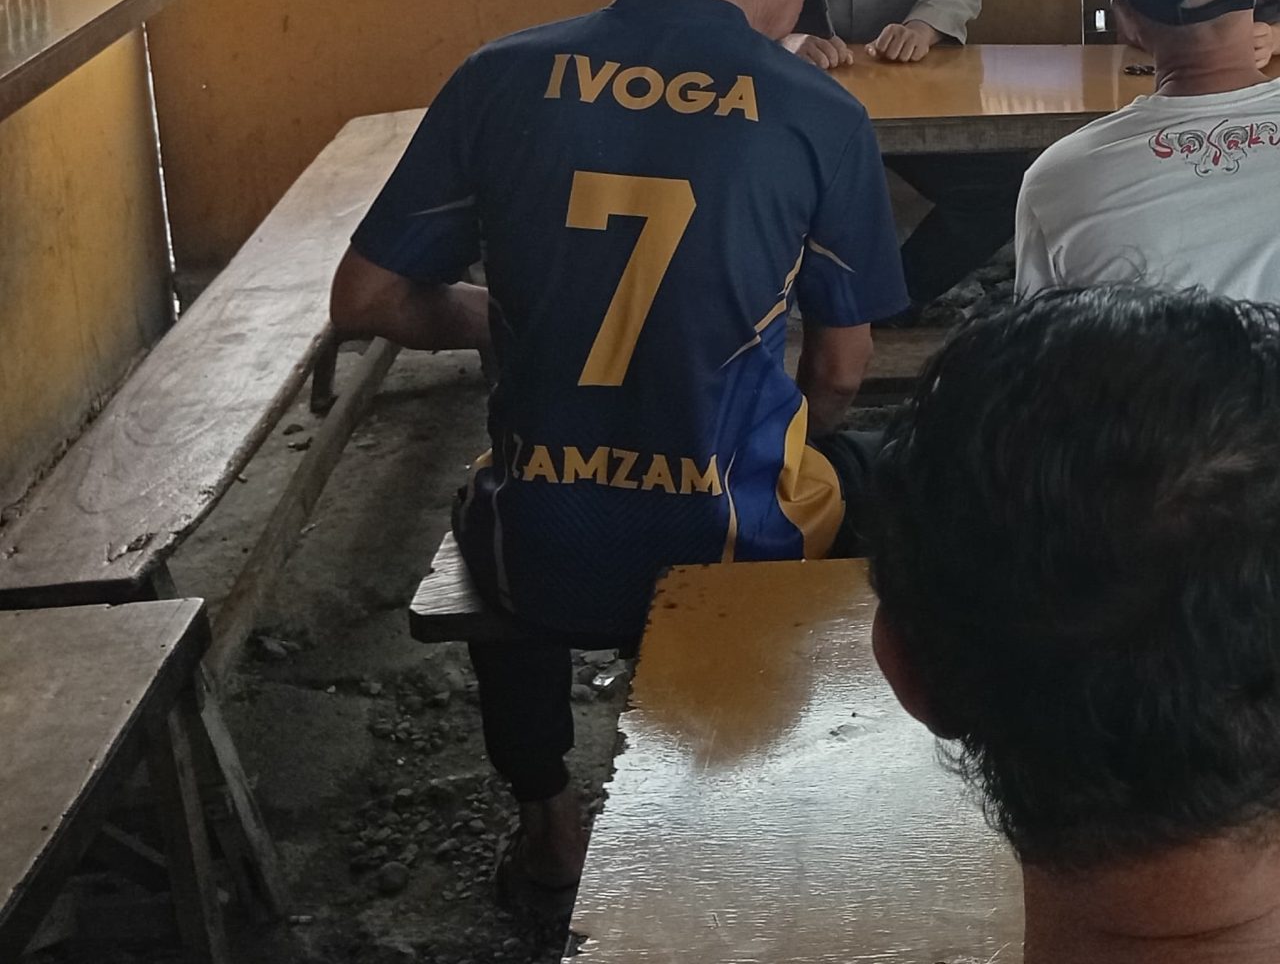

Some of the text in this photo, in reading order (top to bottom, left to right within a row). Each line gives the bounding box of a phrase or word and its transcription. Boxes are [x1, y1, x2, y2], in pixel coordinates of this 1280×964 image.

[544, 54, 760, 122] IVOGA
[565, 170, 697, 387] 7
[515, 444, 723, 497] AMZAM
